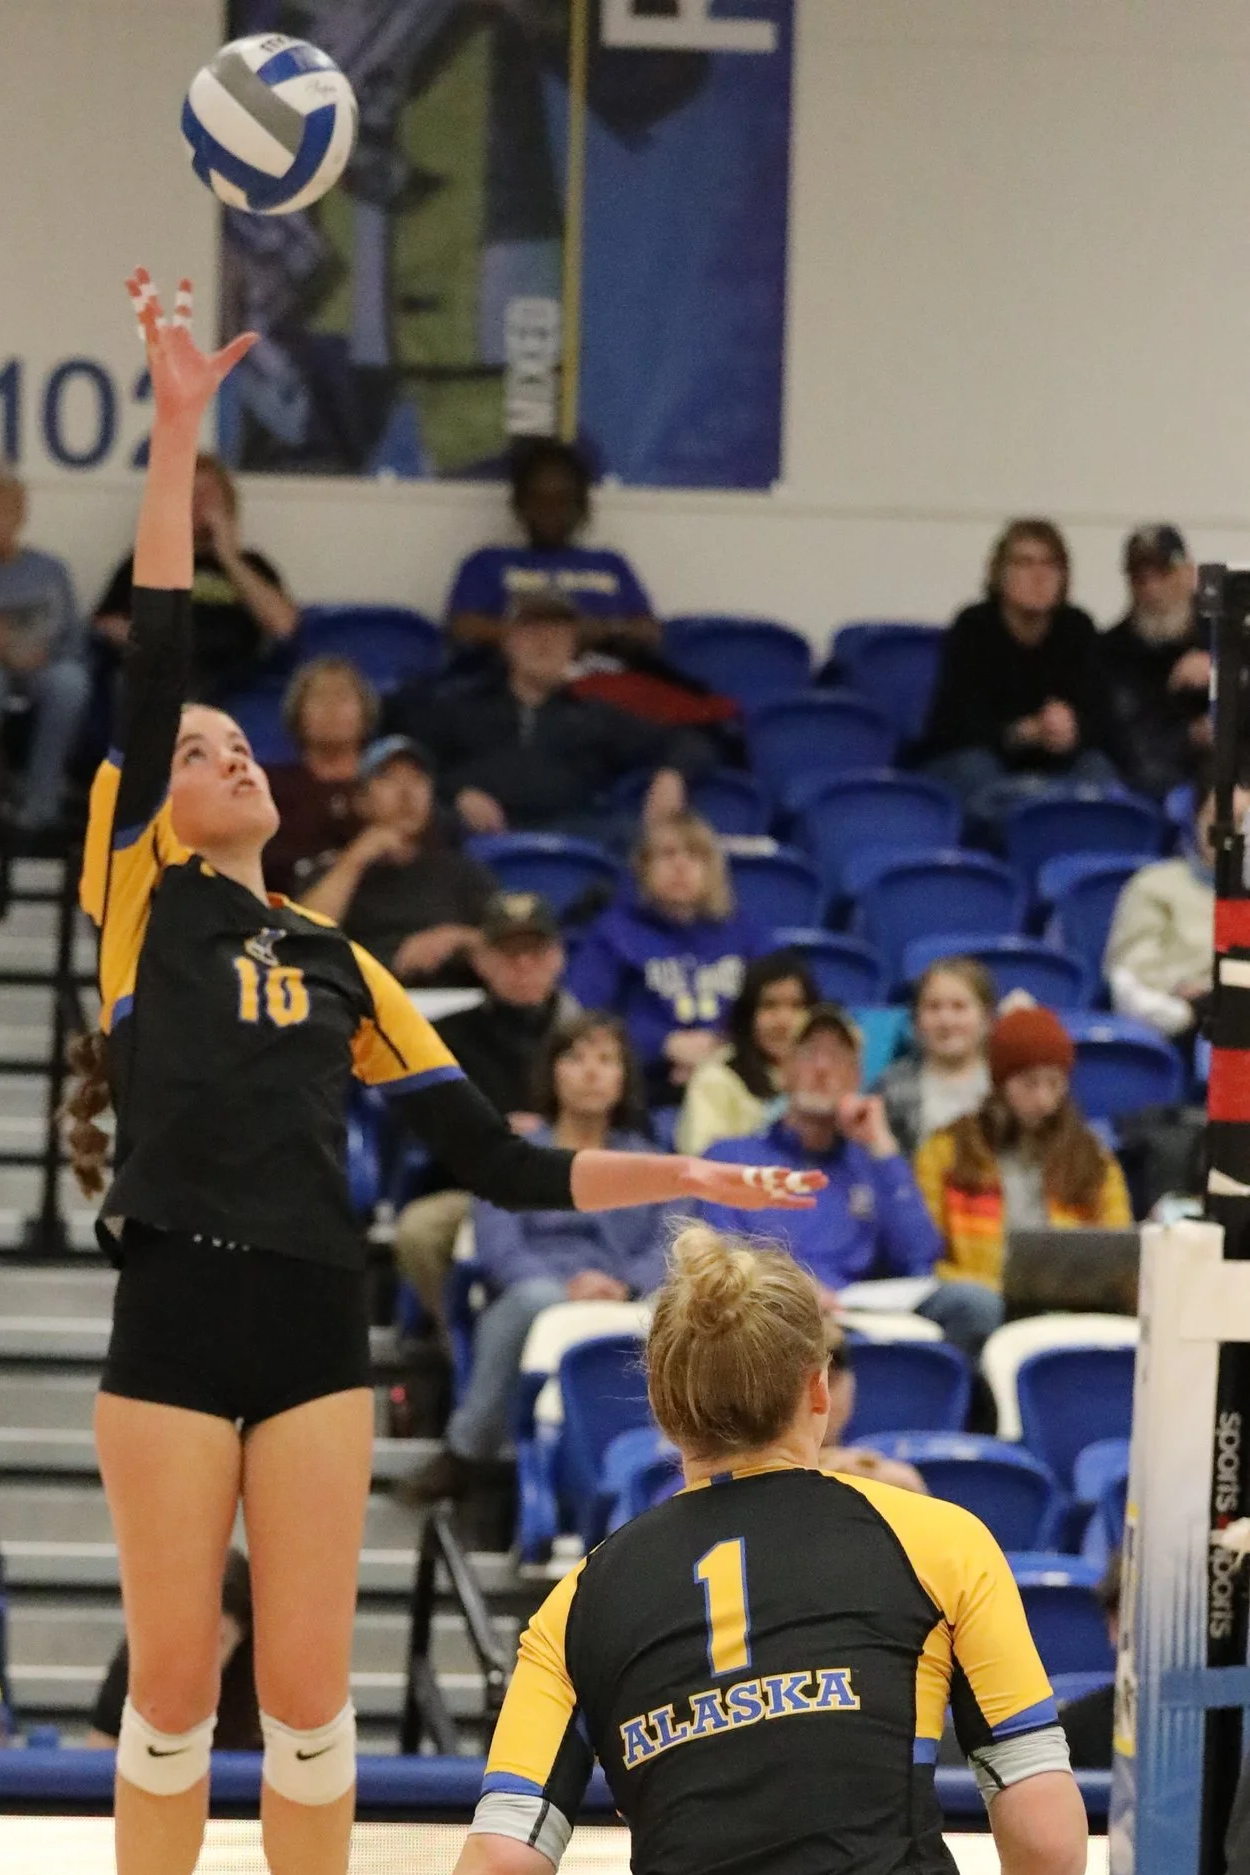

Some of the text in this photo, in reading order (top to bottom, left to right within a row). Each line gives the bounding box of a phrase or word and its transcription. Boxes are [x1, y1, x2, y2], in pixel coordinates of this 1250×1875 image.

[233, 955, 311, 1028] 10
[1209, 1411, 1242, 1640] sports ports
[693, 1537, 751, 1678] 1
[619, 1668, 861, 1770] ALASKA
